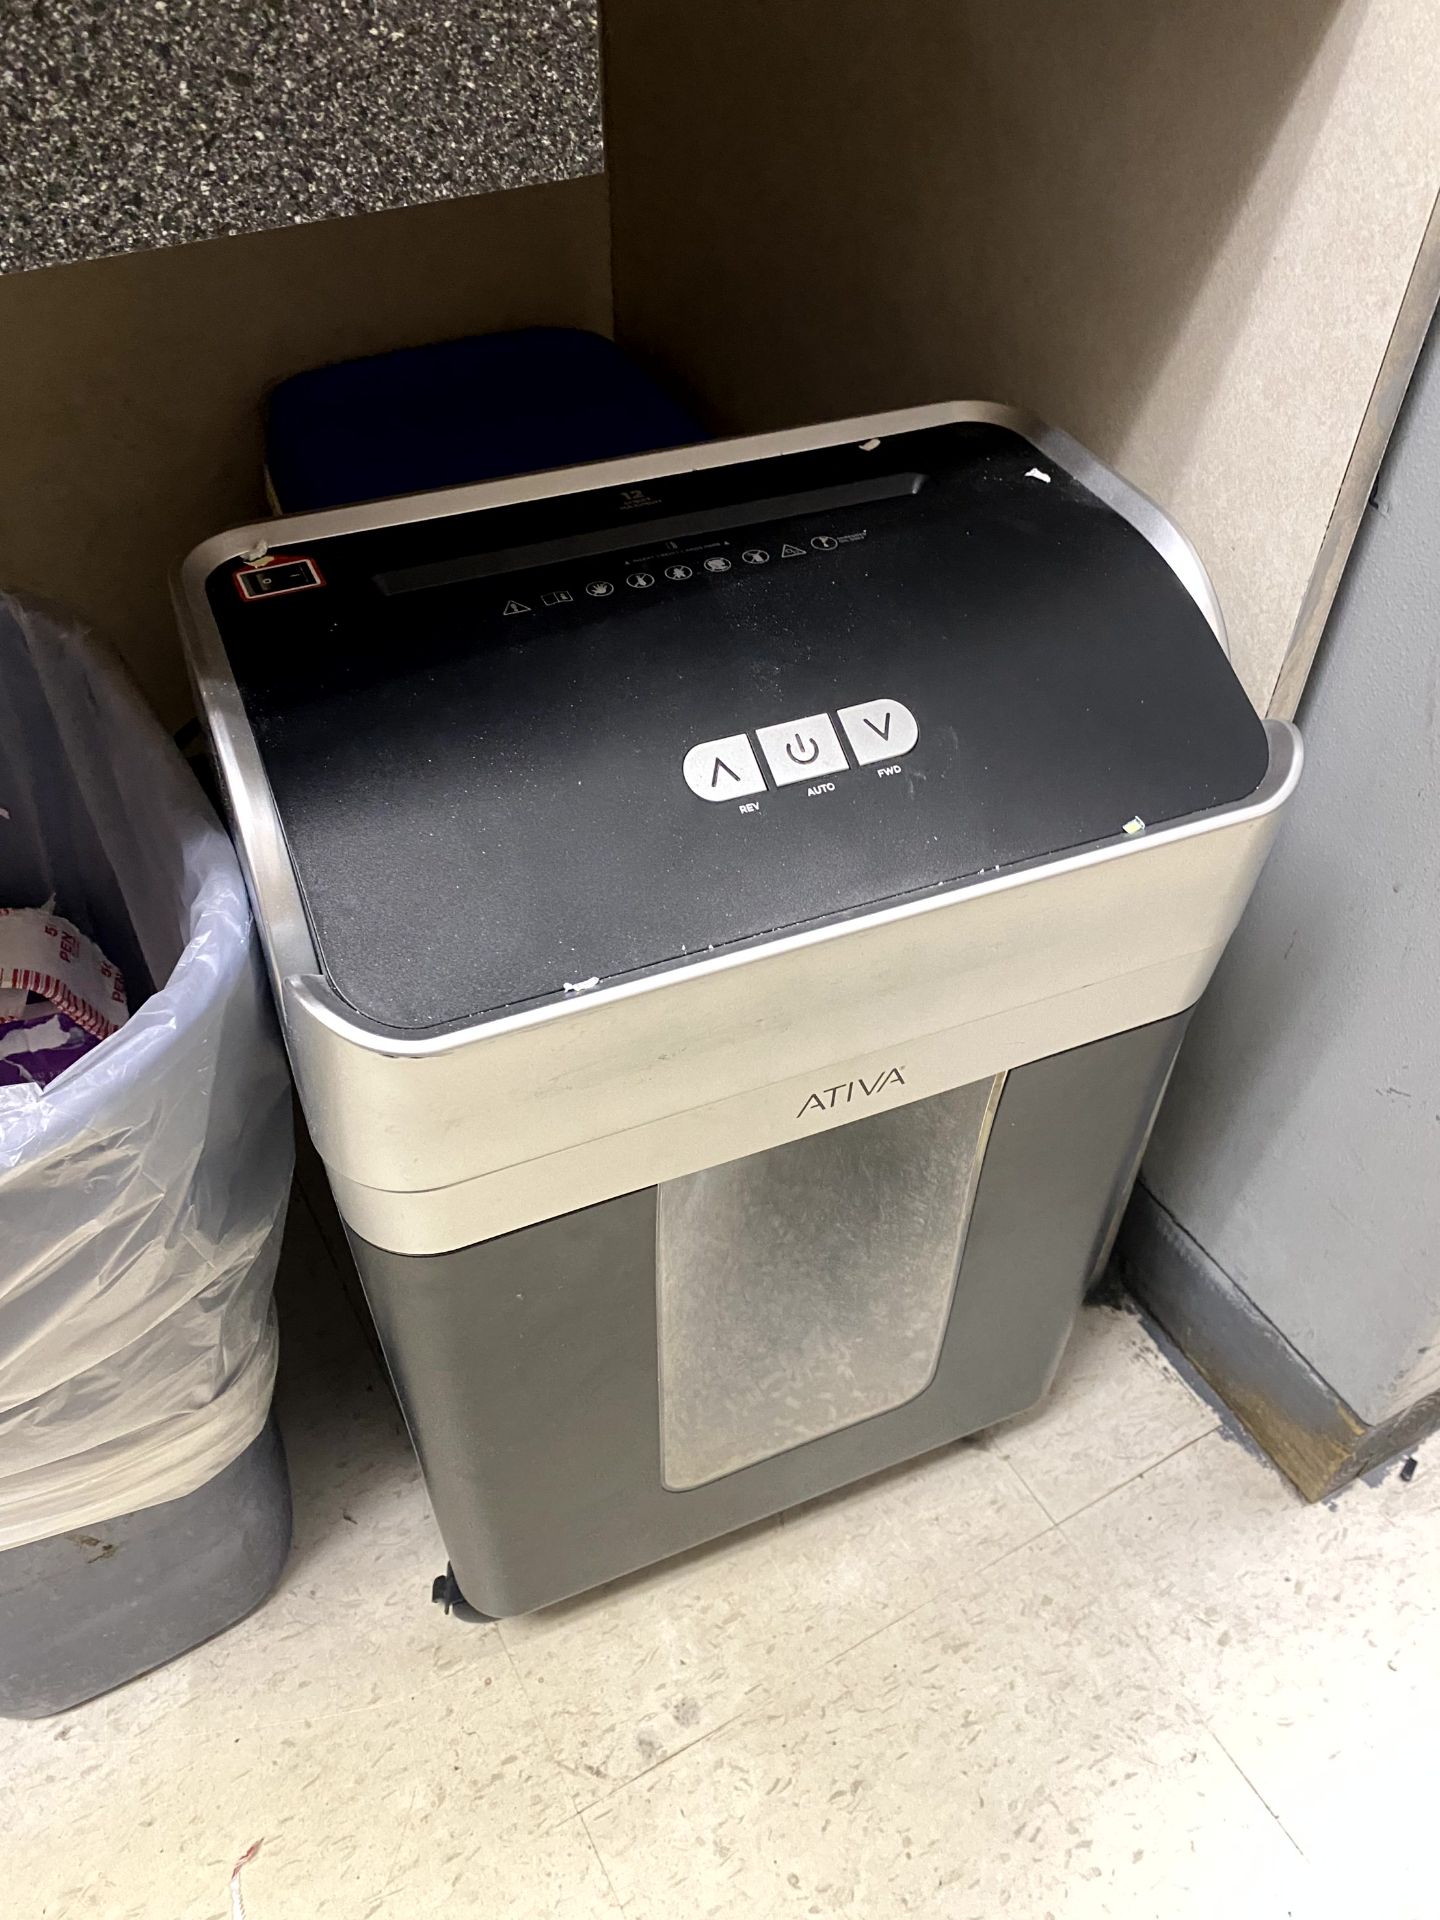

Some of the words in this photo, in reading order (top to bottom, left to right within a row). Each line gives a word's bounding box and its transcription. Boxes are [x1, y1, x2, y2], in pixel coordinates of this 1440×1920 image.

[620, 490, 645, 500] 12
[738, 801, 760, 815] REV
[807, 782, 836, 797] AUTO
[877, 764, 902, 779] FWD
[796, 1067, 905, 1119] ATIVA
